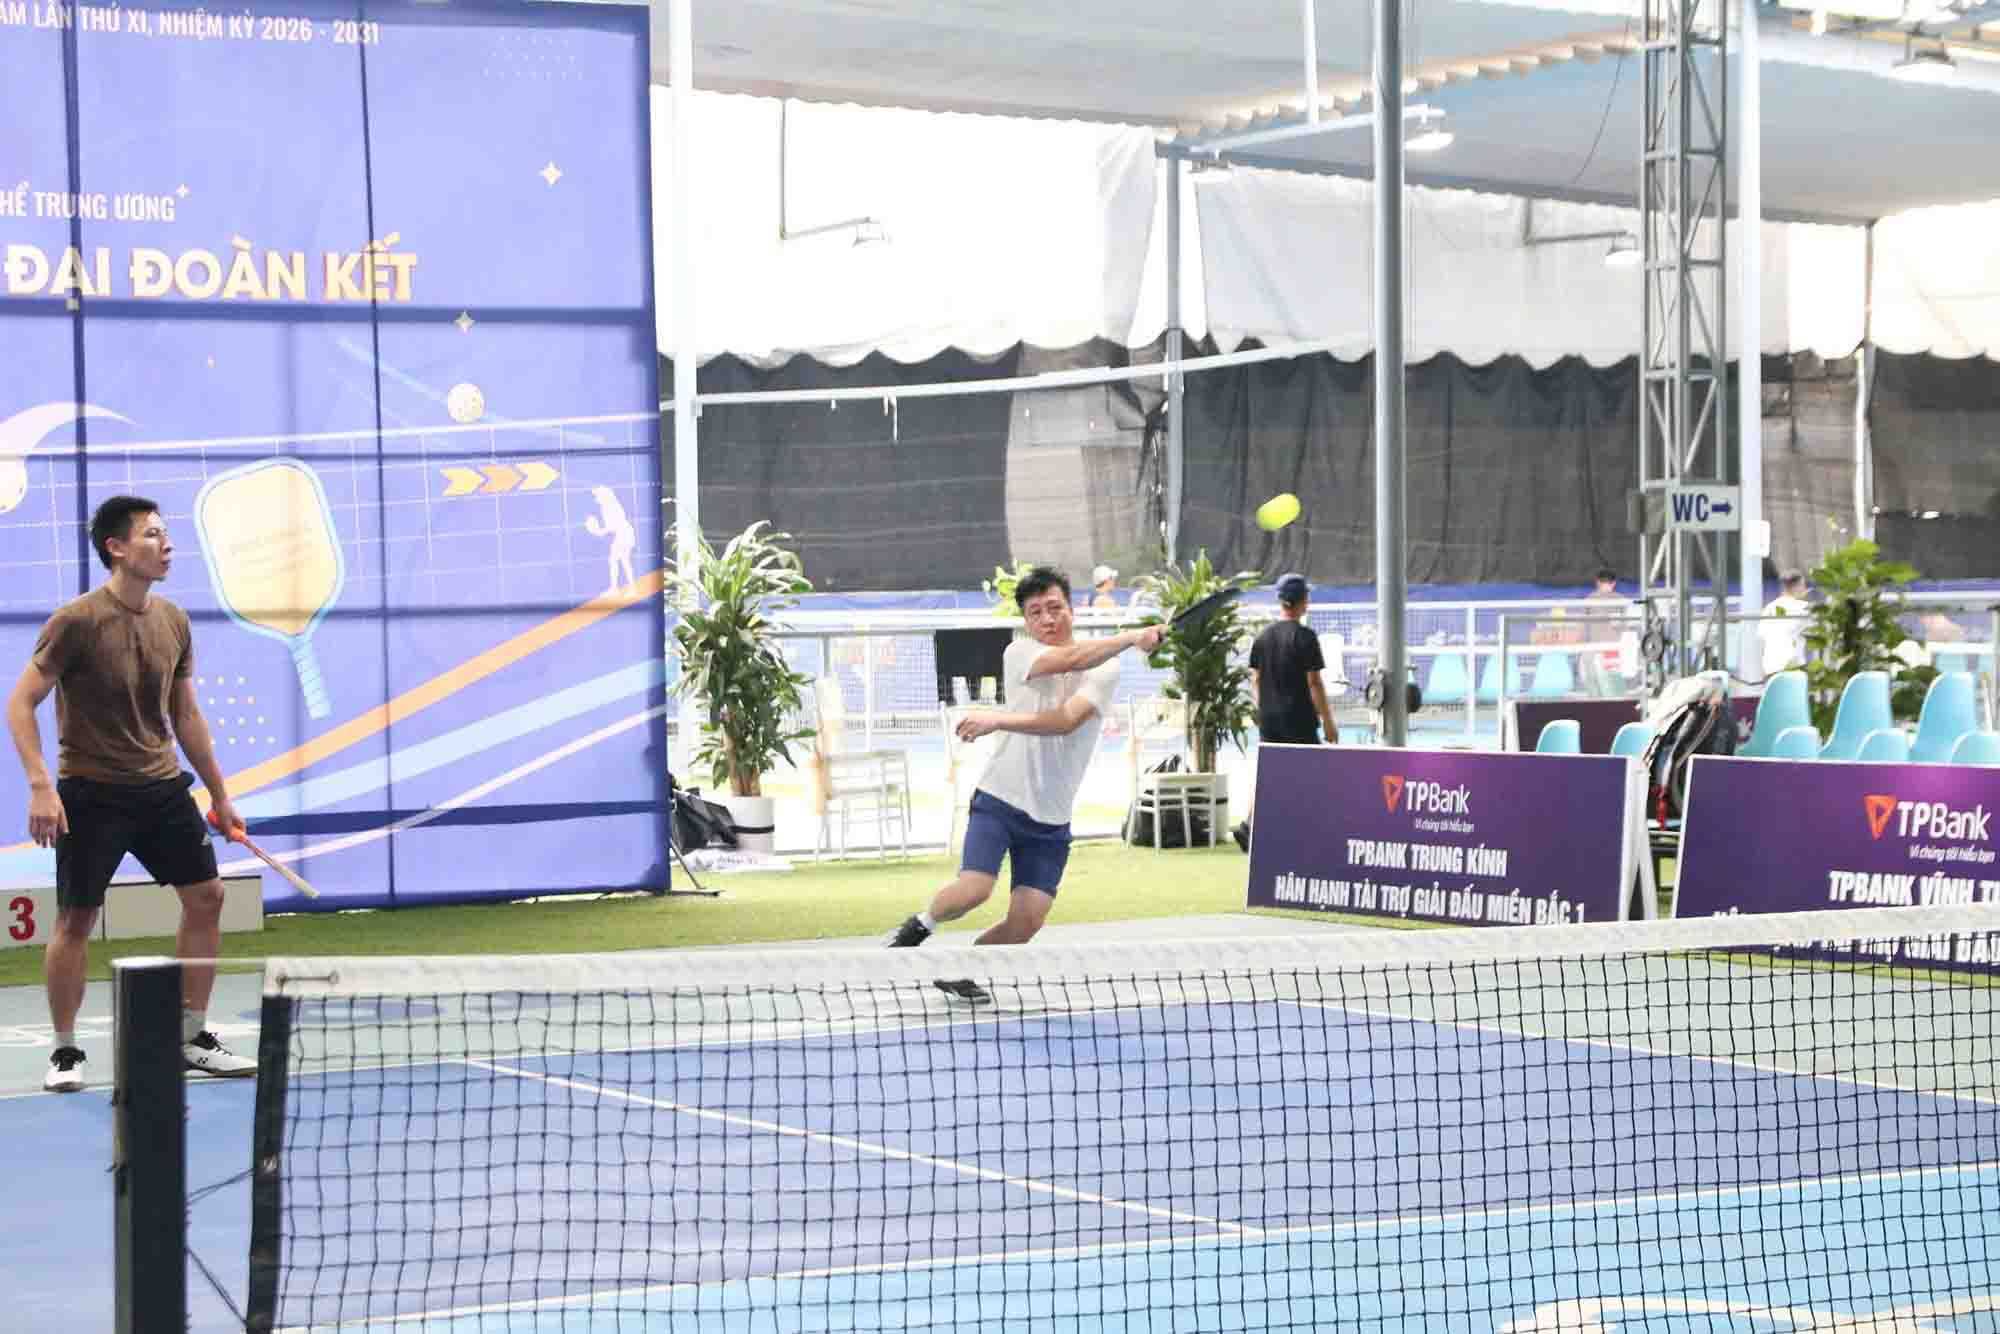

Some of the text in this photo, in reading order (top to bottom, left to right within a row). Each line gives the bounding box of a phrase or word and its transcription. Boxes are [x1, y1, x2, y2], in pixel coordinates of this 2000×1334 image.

[79, 1, 121, 32] THỨ
[127, 9, 152, 37] XI,
[159, 7, 223, 41] NHIỆM
[229, 9, 255, 39] KỲ
[261, 16, 313, 41] 2026
[333, 20, 379, 44] 2031
[33, 192, 107, 221] TRUNG
[114, 193, 176, 221] ƯƠNG
[3, 231, 417, 312] ĐẠI ĐOÀN KẾT
[1671, 492, 1710, 523] WC
[1405, 780, 1471, 815] TPBank
[1897, 801, 1992, 841] TPBank
[1347, 838, 1508, 877] TPBANK TRUNG KÍNH
[1275, 871, 1306, 902] HÂN
[1308, 878, 1350, 910] HẠNH
[1352, 878, 1377, 910] TÀI
[1380, 884, 1411, 918] TRỢ
[1412, 880, 1446, 917] GIẢI
[1449, 883, 1483, 921] ĐẤU
[1535, 889, 1571, 925] BẮC
[1829, 870, 1915, 906] TPBANK
[1920, 870, 1975, 906] VĨNH
[8, 896, 35, 940] 3
